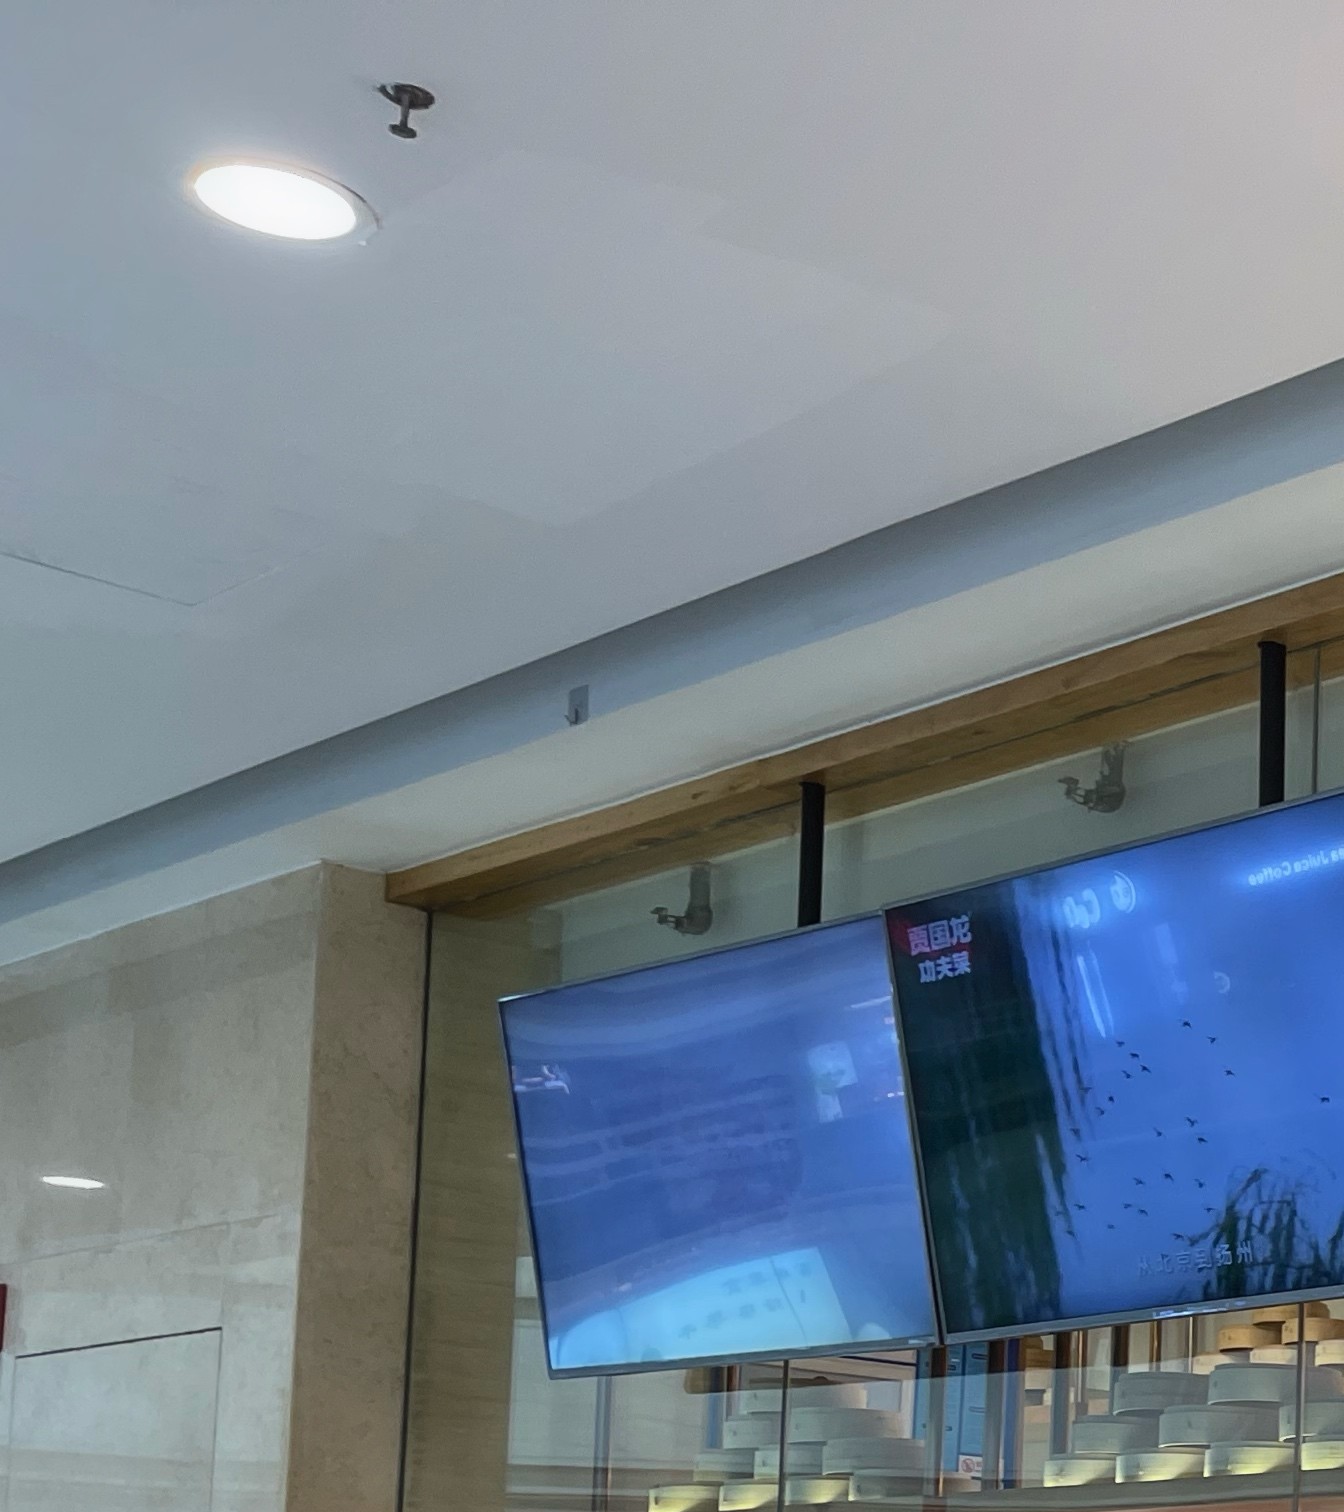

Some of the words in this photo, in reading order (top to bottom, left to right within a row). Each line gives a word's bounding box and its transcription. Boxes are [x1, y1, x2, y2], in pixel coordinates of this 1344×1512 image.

[907, 914, 972, 956] 贾国龙
[918, 951, 971, 983] 功夫菜
